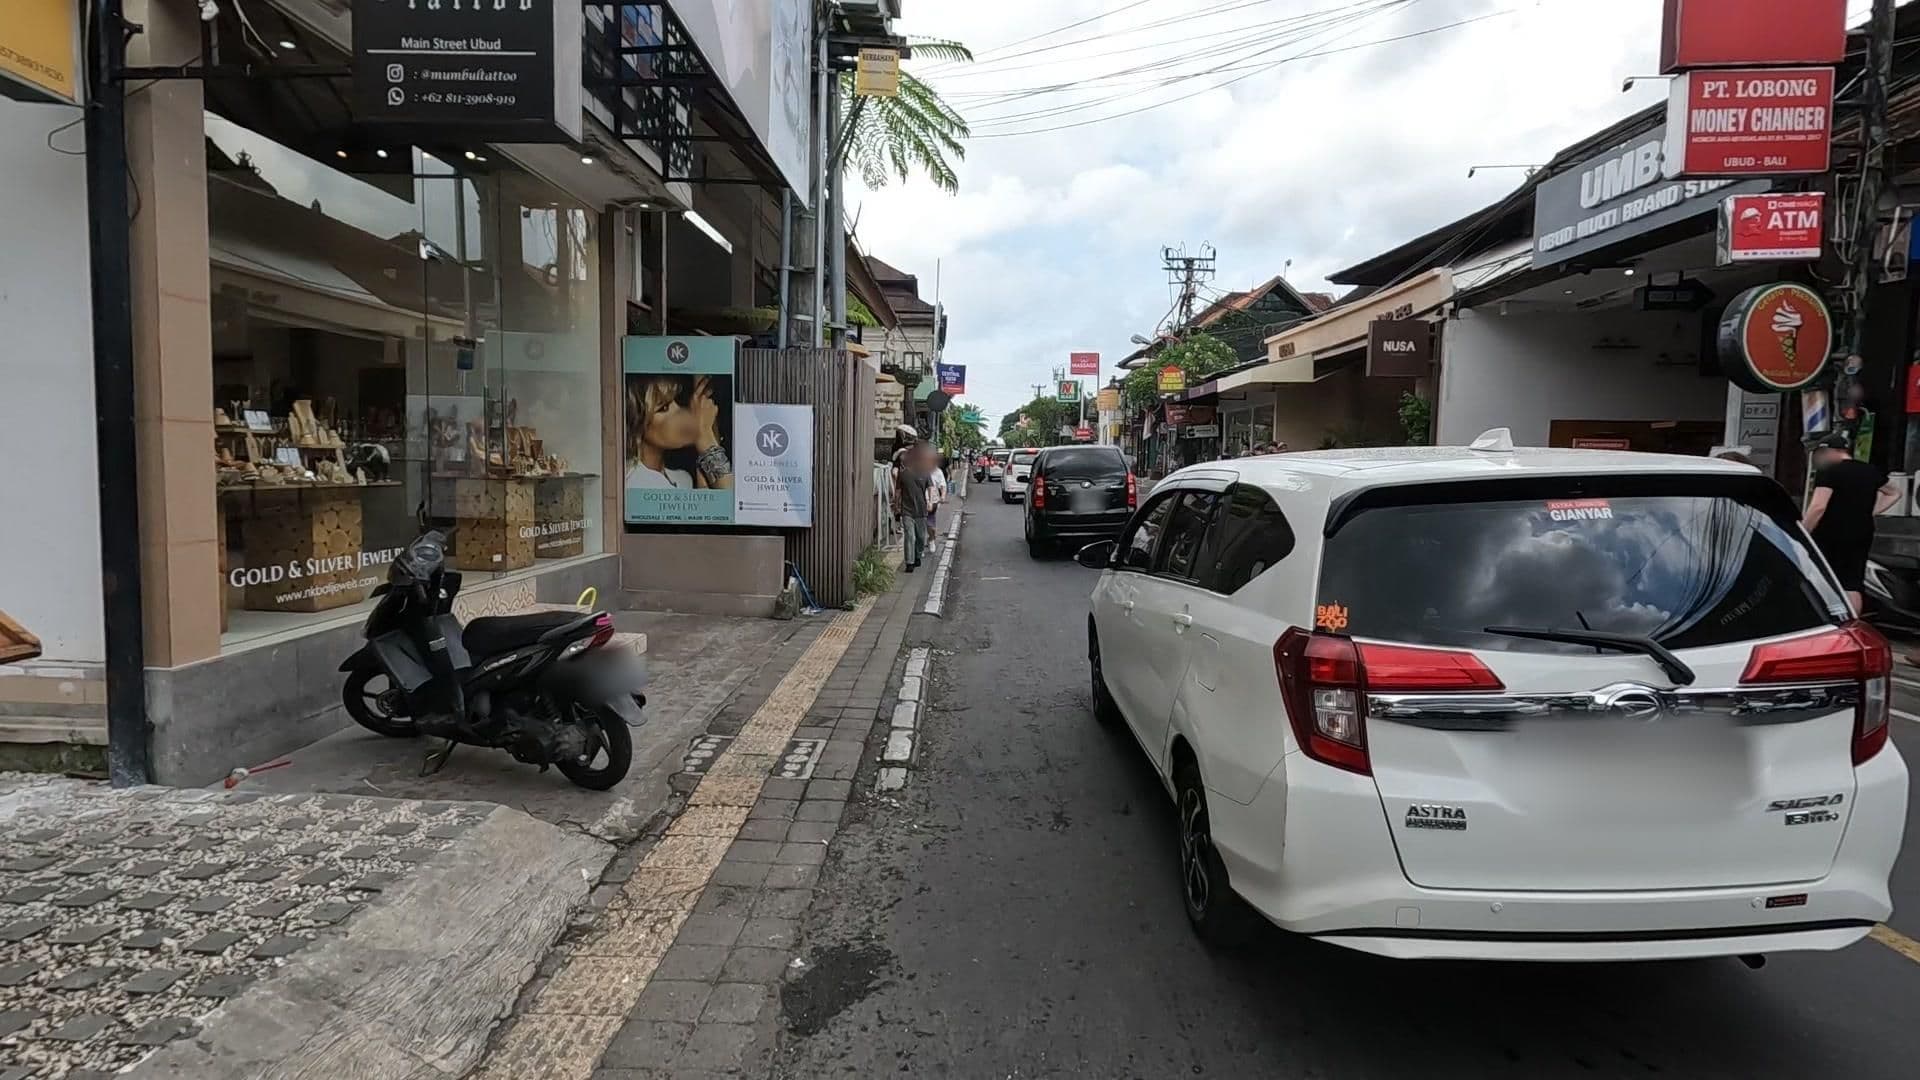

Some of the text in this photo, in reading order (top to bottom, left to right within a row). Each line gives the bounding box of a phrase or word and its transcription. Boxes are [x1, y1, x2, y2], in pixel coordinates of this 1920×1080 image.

[401, 37, 502, 50] Main Street Ubud
[421, 68, 518, 81] @mumbultattoo
[1702, 79, 1818, 98] PT. LOBONG
[421, 92, 516, 105] +62 811-3908-919
[1691, 106, 1825, 133] MONEY CHANGER
[1724, 157, 1755, 167] UBUD
[1763, 156, 1787, 167] BALI
[1539, 226, 1577, 252] UBUD
[1577, 208, 1620, 239] MULTI
[1621, 184, 1683, 222] BRAND
[1767, 210, 1818, 230] ATM
[1383, 340, 1416, 352] NUSA
[743, 475, 803, 484] GOLD & SILVER
[757, 484, 790, 492] JEWELRY
[642, 492, 672, 501] GOLD
[683, 492, 715, 501] SILVER
[658, 502, 699, 511] JEWELRY
[1550, 507, 1614, 521] GIANYAR
[520, 526, 541, 538] GOLD
[541, 523, 548, 536] &
[548, 521, 569, 535] SILVER
[230, 565, 284, 588] GOLD
[288, 560, 303, 579] &
[306, 555, 353, 576] SILVER
[1317, 604, 1348, 617] BALI
[1316, 616, 1348, 629] ZOO
[1765, 793, 1843, 812] SIGRA
[1407, 803, 1467, 819] ASTRA
